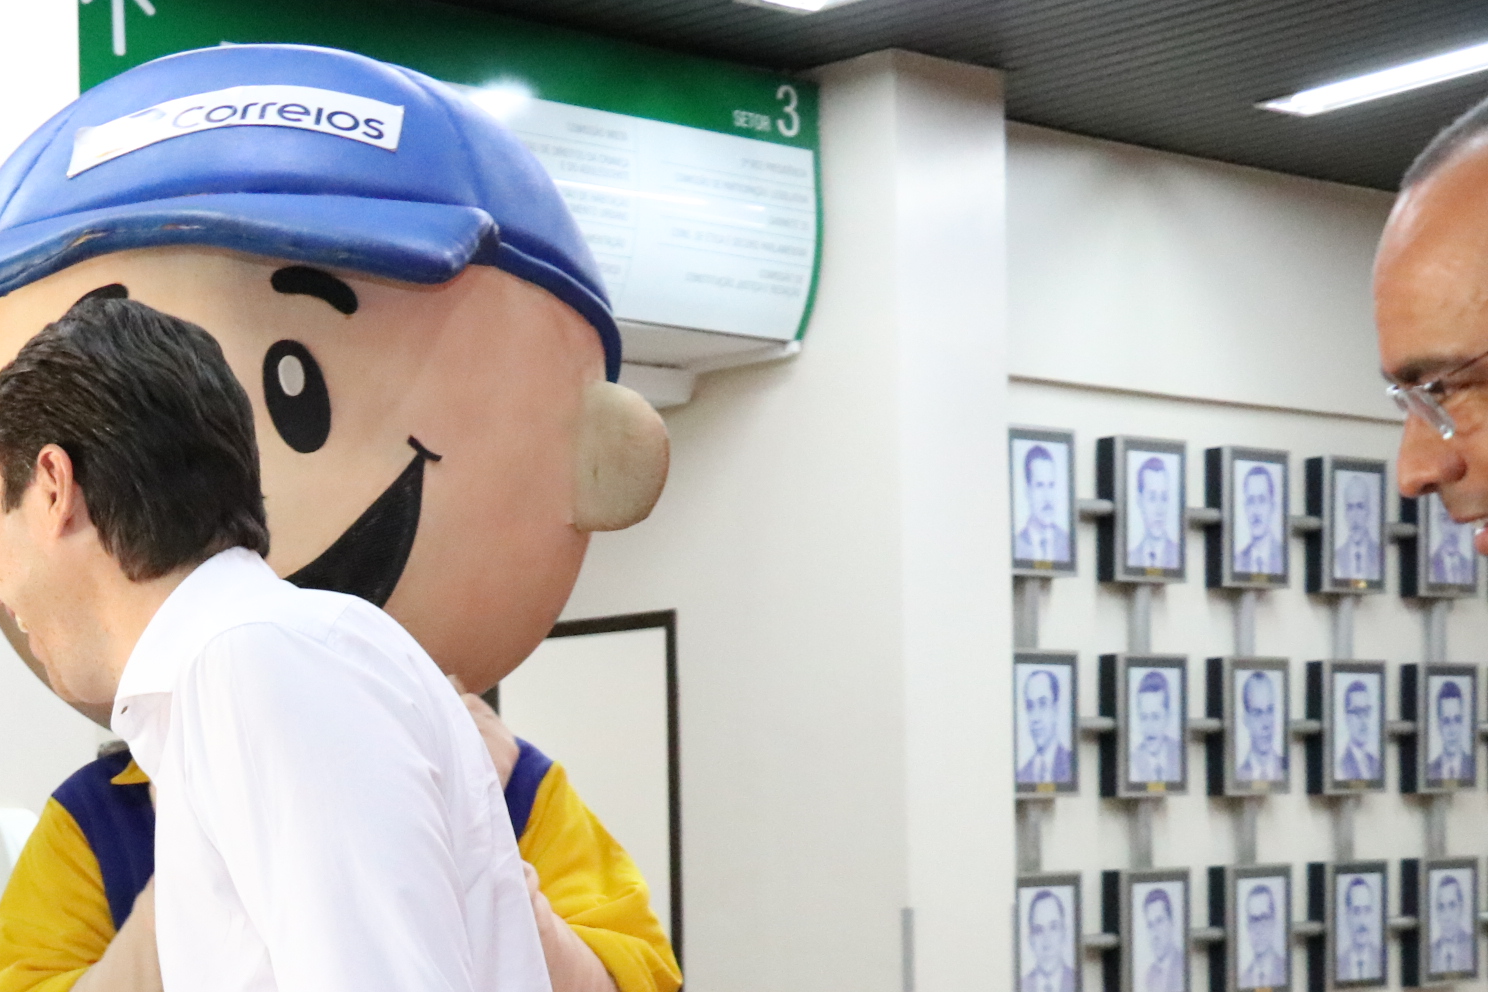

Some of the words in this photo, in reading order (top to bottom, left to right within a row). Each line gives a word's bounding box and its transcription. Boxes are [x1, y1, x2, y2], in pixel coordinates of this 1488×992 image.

[172, 101, 385, 141] Correios
[733, 109, 771, 132] SETOR
[776, 84, 800, 137] 3
